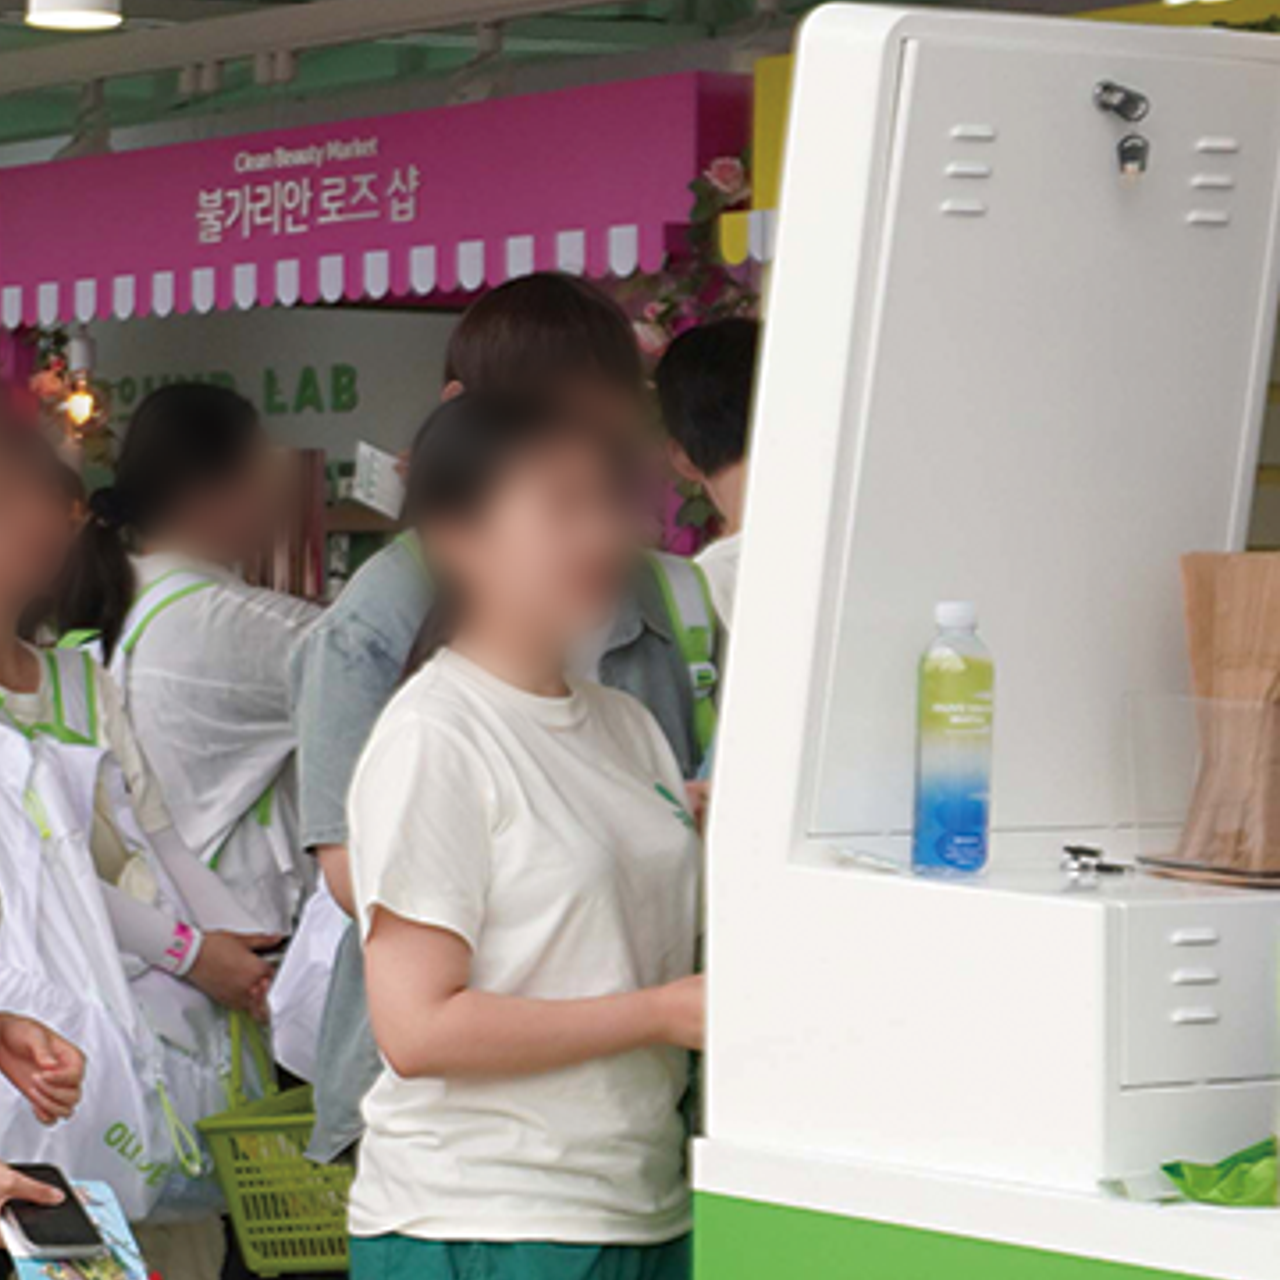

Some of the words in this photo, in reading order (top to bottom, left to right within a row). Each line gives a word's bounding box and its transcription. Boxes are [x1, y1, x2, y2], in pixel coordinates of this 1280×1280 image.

[195, 176, 313, 245] 불가리안
[316, 172, 381, 225] 로즈
[386, 163, 421, 223] 샵
[262, 362, 359, 415] LAB
